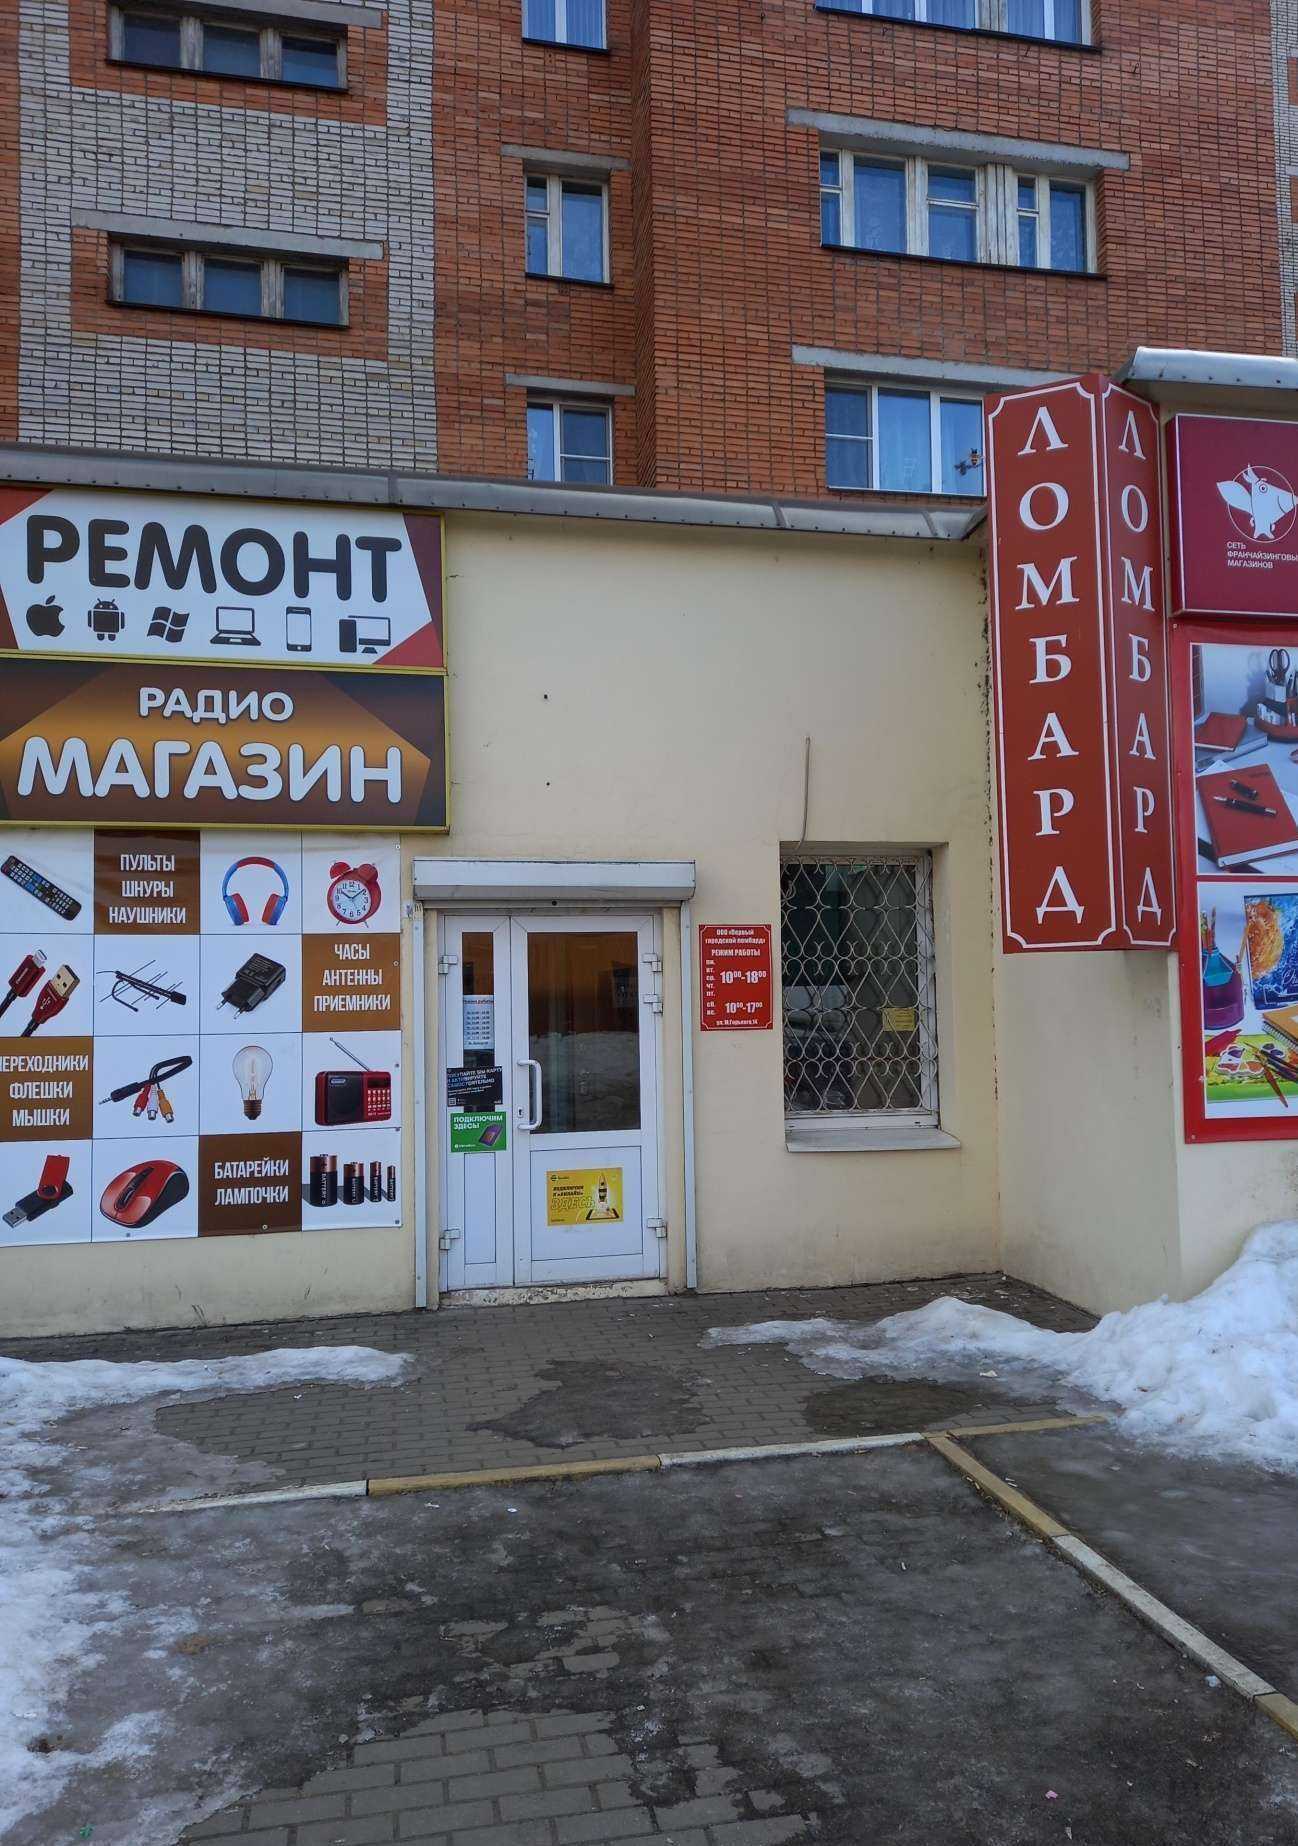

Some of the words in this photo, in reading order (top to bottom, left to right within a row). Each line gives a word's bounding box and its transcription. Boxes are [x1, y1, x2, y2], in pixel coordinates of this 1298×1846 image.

[1227, 541, 1246, 549] СЕТЬ
[26, 514, 402, 603] РЕМОНТ
[1227, 559, 1273, 569] МАГАЗИНОВ
[1015, 406, 1085, 924] ЛОМБАРД
[1118, 410, 1162, 926] ЛОМБАРД
[139, 687, 294, 724] РАДИО
[17, 736, 402, 803] МАГАЗИН
[120, 854, 175, 871] ПУЛЬТЫ
[121, 880, 174, 897] ШНУРЫ
[108, 907, 186, 923] НАУШНИКИ
[334, 943, 370, 960] ЧАСЫ
[735, 948, 761, 956] РАБОТЫ
[322, 969, 382, 986] АНТЕННЫ
[313, 994, 391, 1012] ПРИЕМНИКИ
[9, 1081, 73, 1099] ФЛЕШКИ
[12, 1109, 70, 1127] МЫШКИ
[214, 1157, 289, 1179] БАТАРЕЙКИ
[214, 1186, 289, 1206] ЛАМПОЧКИ
